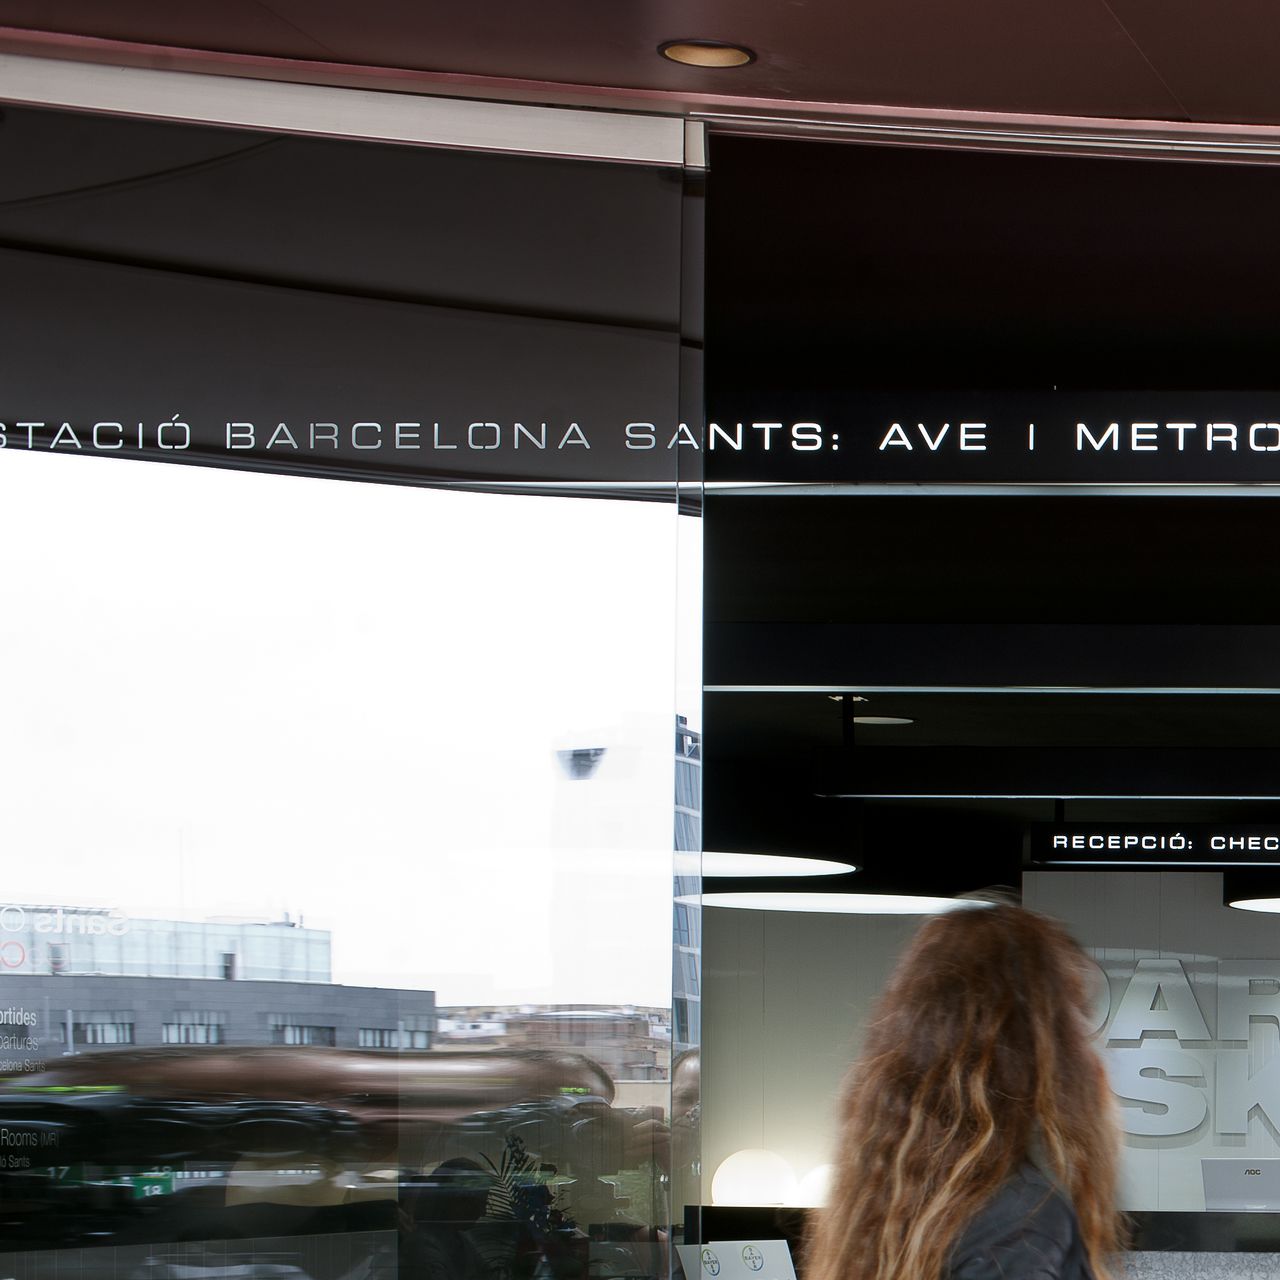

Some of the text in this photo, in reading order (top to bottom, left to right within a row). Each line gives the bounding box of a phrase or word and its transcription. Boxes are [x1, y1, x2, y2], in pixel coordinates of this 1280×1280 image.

[0, 414, 191, 449] TACIÓ
[226, 422, 591, 450] BARCELONA
[625, 422, 840, 452] SANTS:
[878, 422, 987, 451] AVE
[1053, 832, 1193, 850] RECEPCIÓ:
[1, 1129, 38, 1147] Rooms
